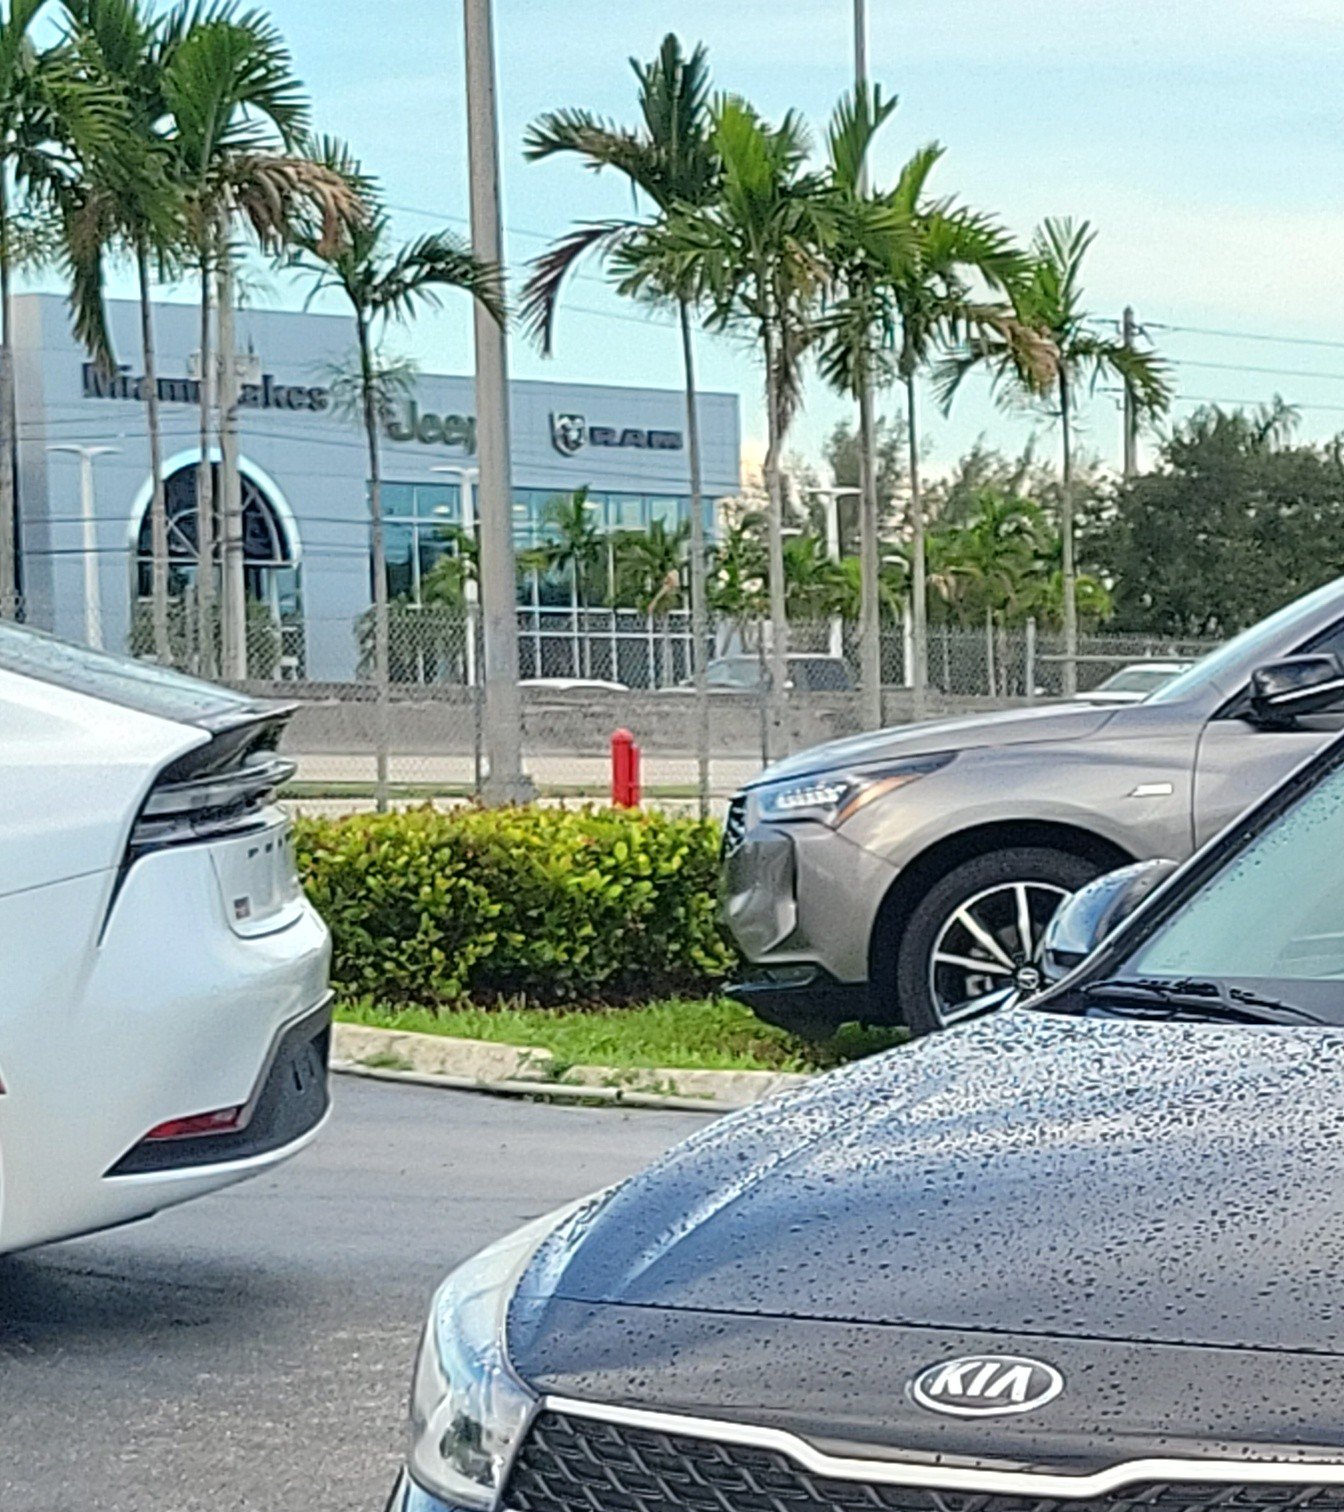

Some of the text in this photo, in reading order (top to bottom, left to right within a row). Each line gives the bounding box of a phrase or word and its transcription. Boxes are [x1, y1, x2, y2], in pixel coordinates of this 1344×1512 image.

[235, 373, 331, 412] akes
[588, 426, 684, 450] RAM
[929, 1361, 1034, 1402] KIA
